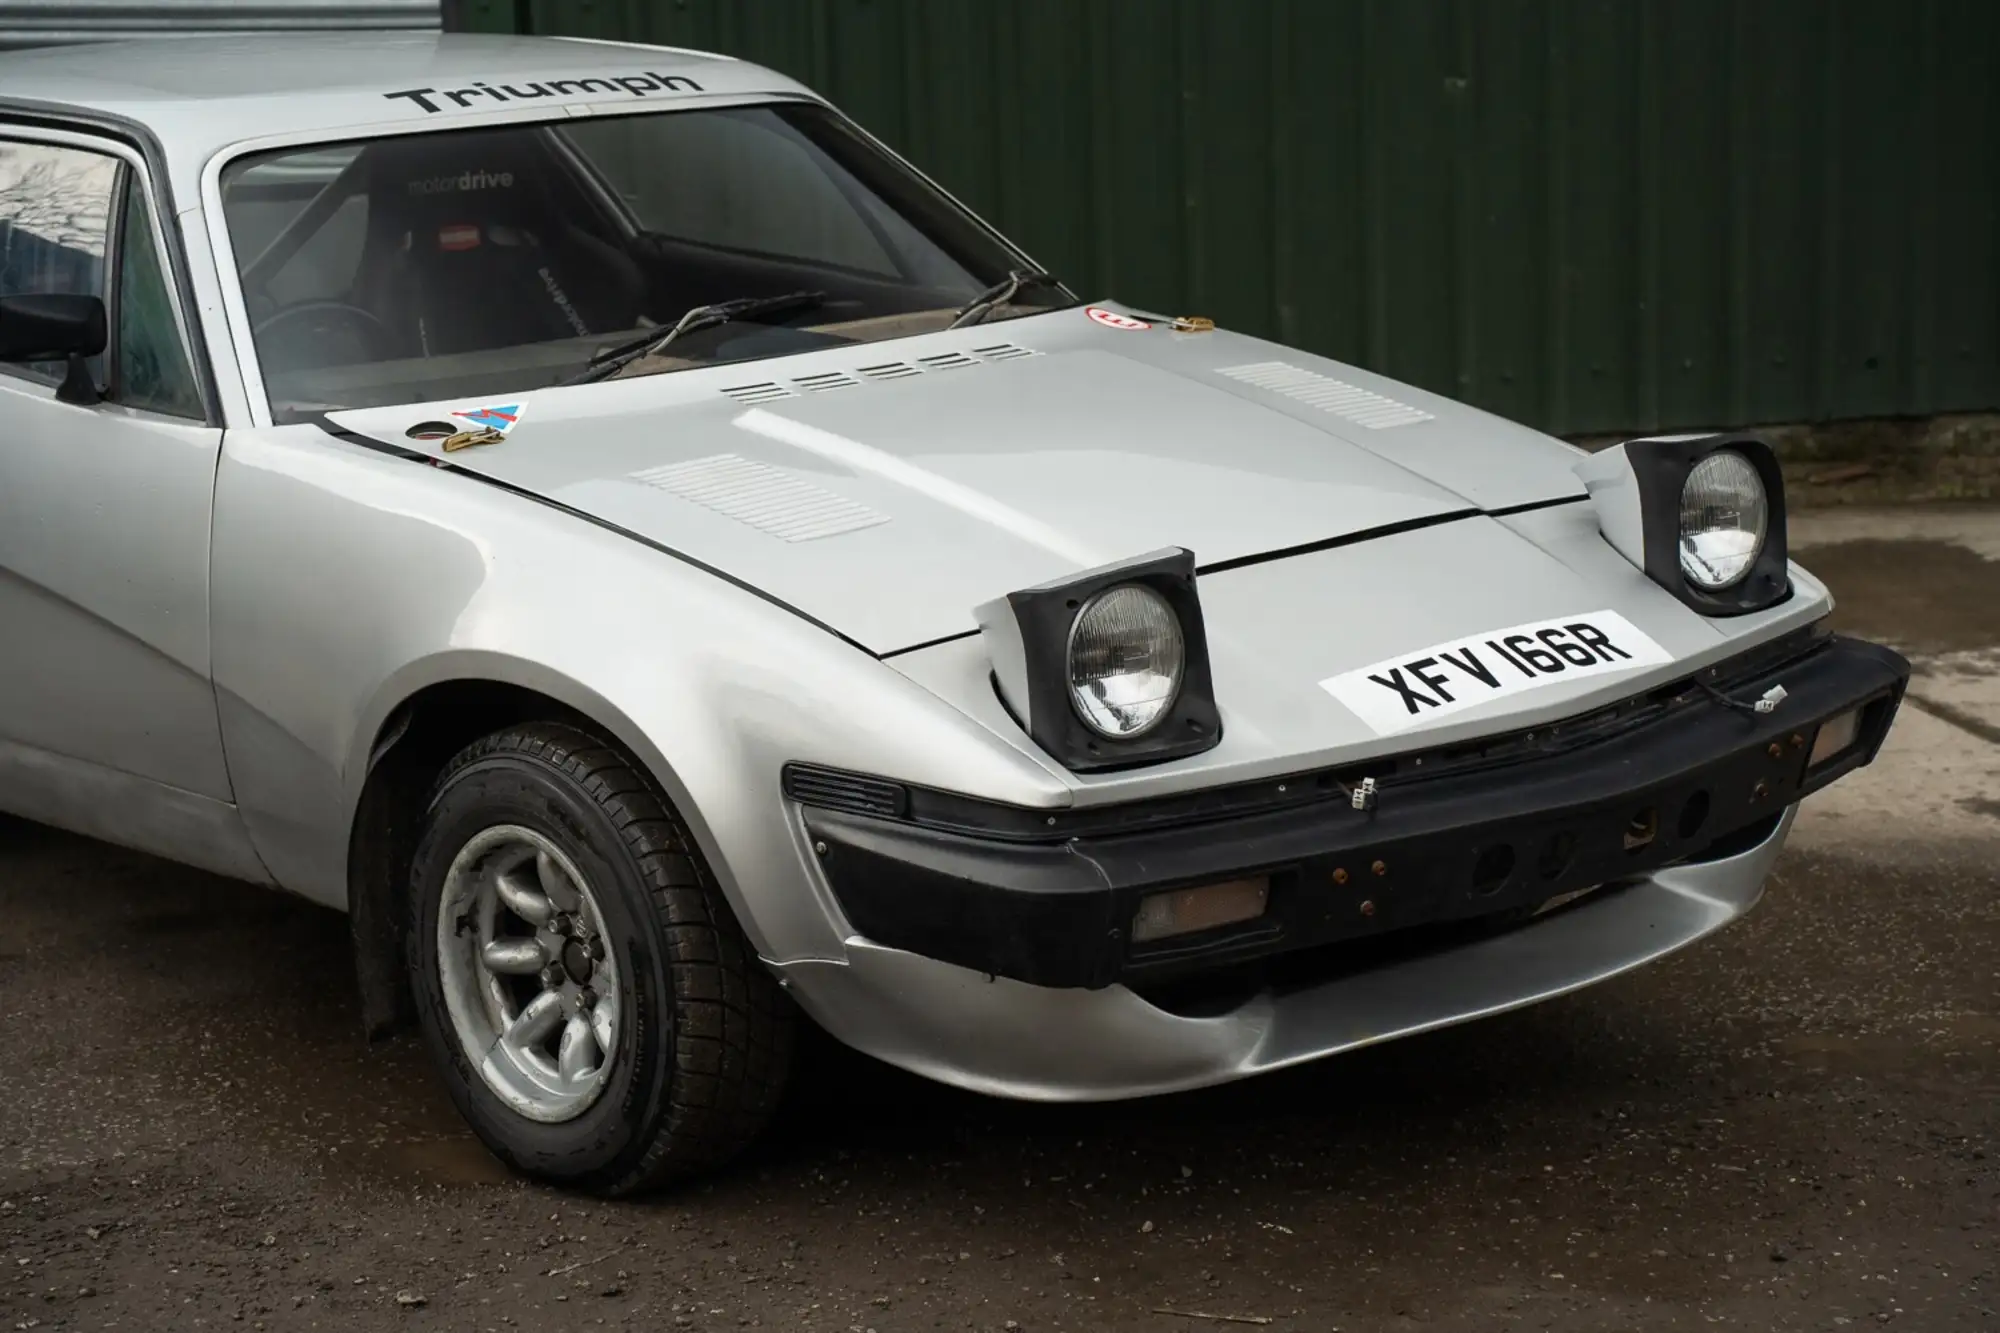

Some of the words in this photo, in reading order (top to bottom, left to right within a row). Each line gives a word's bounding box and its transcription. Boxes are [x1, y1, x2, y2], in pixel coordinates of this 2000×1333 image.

[384, 72, 704, 114] Triumph
[408, 168, 514, 196] motordrive
[1367, 647, 1502, 715] XFV
[1485, 623, 1633, 678] 166R
